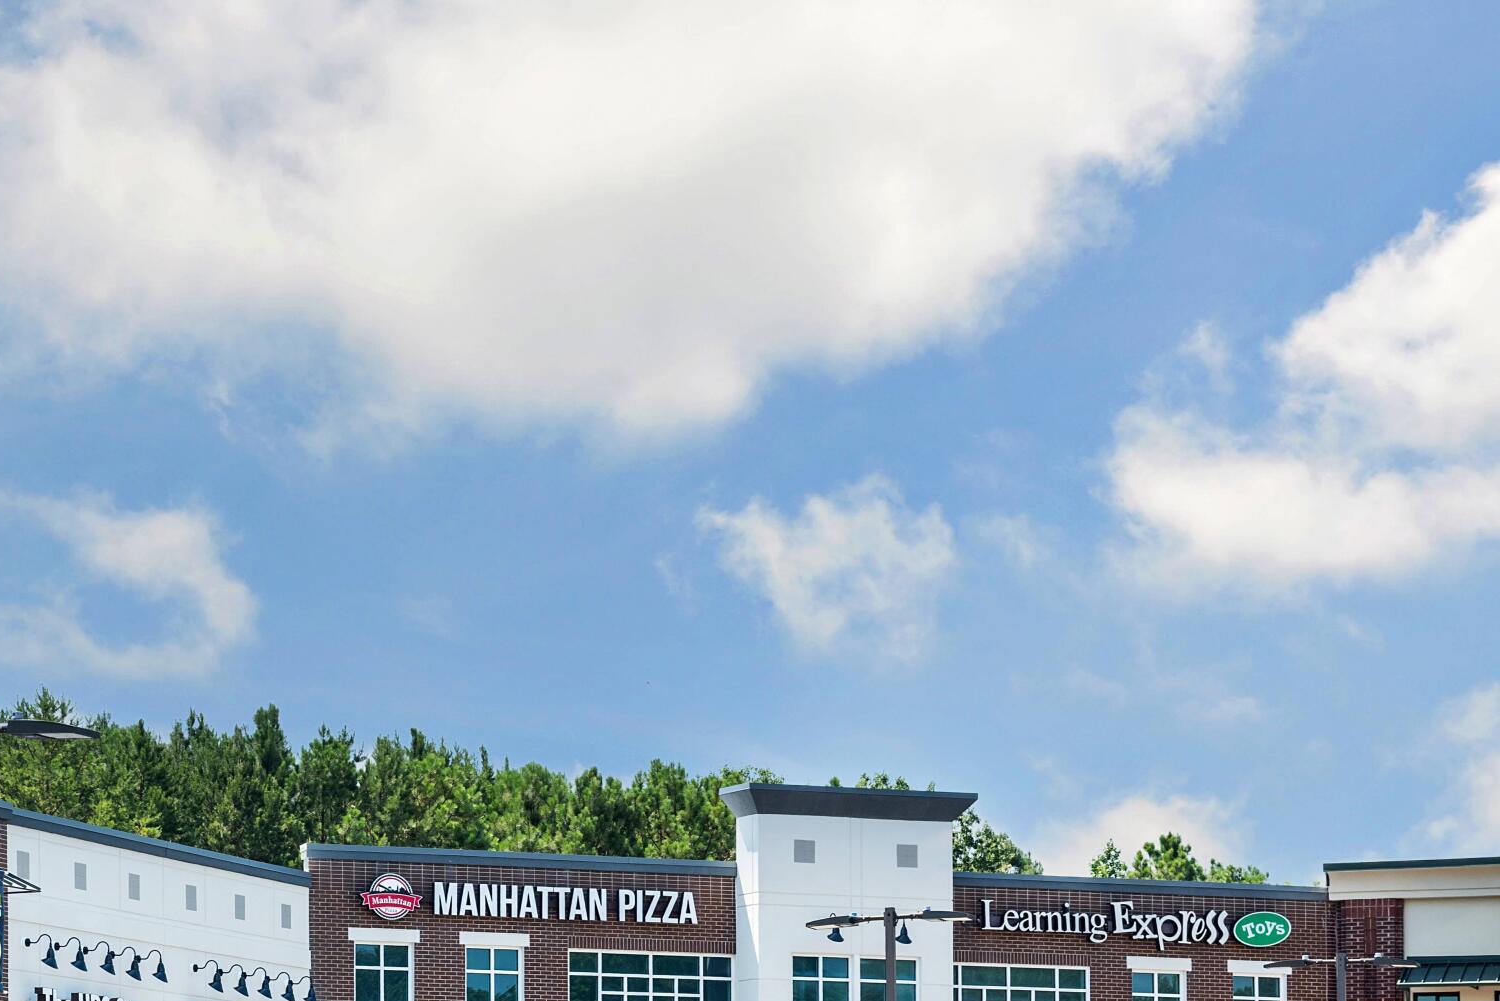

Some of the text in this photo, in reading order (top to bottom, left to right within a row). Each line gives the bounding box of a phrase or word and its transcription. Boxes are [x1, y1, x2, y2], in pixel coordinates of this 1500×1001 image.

[371, 896, 412, 907] Manhattan
[434, 882, 698, 925] MANHATTAN PIZZA
[981, 900, 1230, 950] Learning Express
